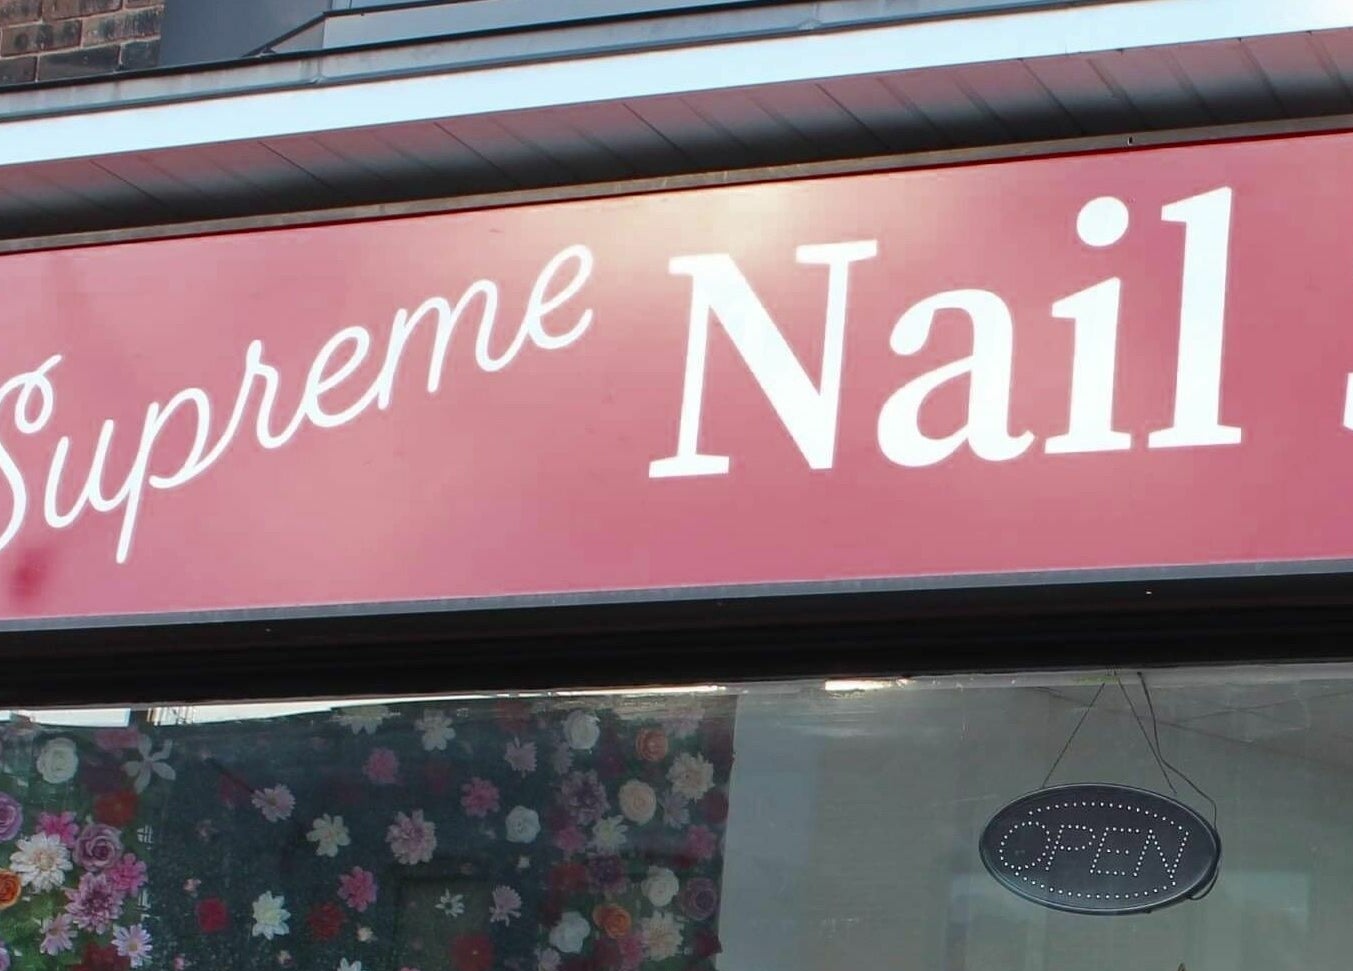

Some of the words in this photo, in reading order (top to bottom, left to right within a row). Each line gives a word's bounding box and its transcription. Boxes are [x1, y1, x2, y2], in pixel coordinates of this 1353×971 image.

[0, 243, 595, 564] Supreme
[648, 185, 1242, 479] Nail
[999, 820, 1190, 877] OPEN
